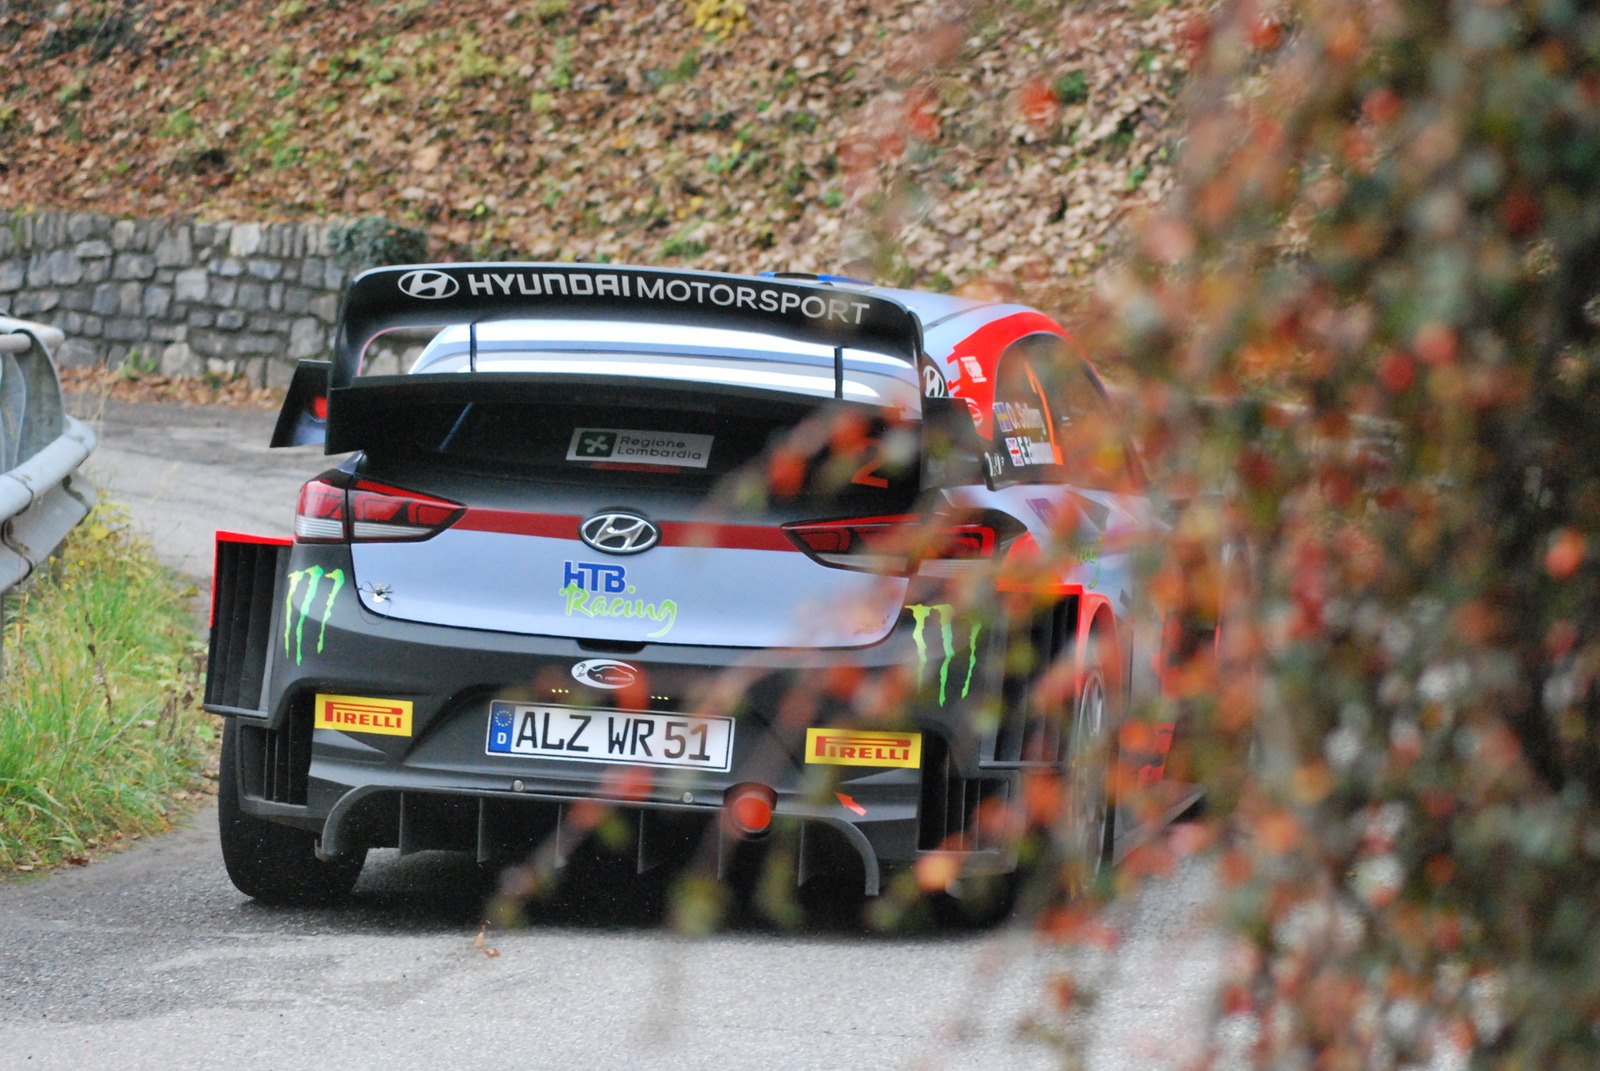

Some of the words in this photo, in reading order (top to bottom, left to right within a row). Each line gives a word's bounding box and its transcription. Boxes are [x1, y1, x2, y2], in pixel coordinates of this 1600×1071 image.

[467, 273, 631, 297] HYUNDAI
[636, 276, 871, 325] MOTORSPORT
[617, 446, 702, 460] Lombardia
[619, 436, 686, 449] Regione
[563, 560, 626, 593] HTB
[559, 582, 678, 637] Racing
[324, 700, 404, 729] PIRELLI
[496, 732, 507, 745] D
[515, 711, 592, 752] ALZ
[607, 716, 655, 757] WR
[663, 721, 711, 762] 51
[814, 735, 912, 761] PIRELLI
